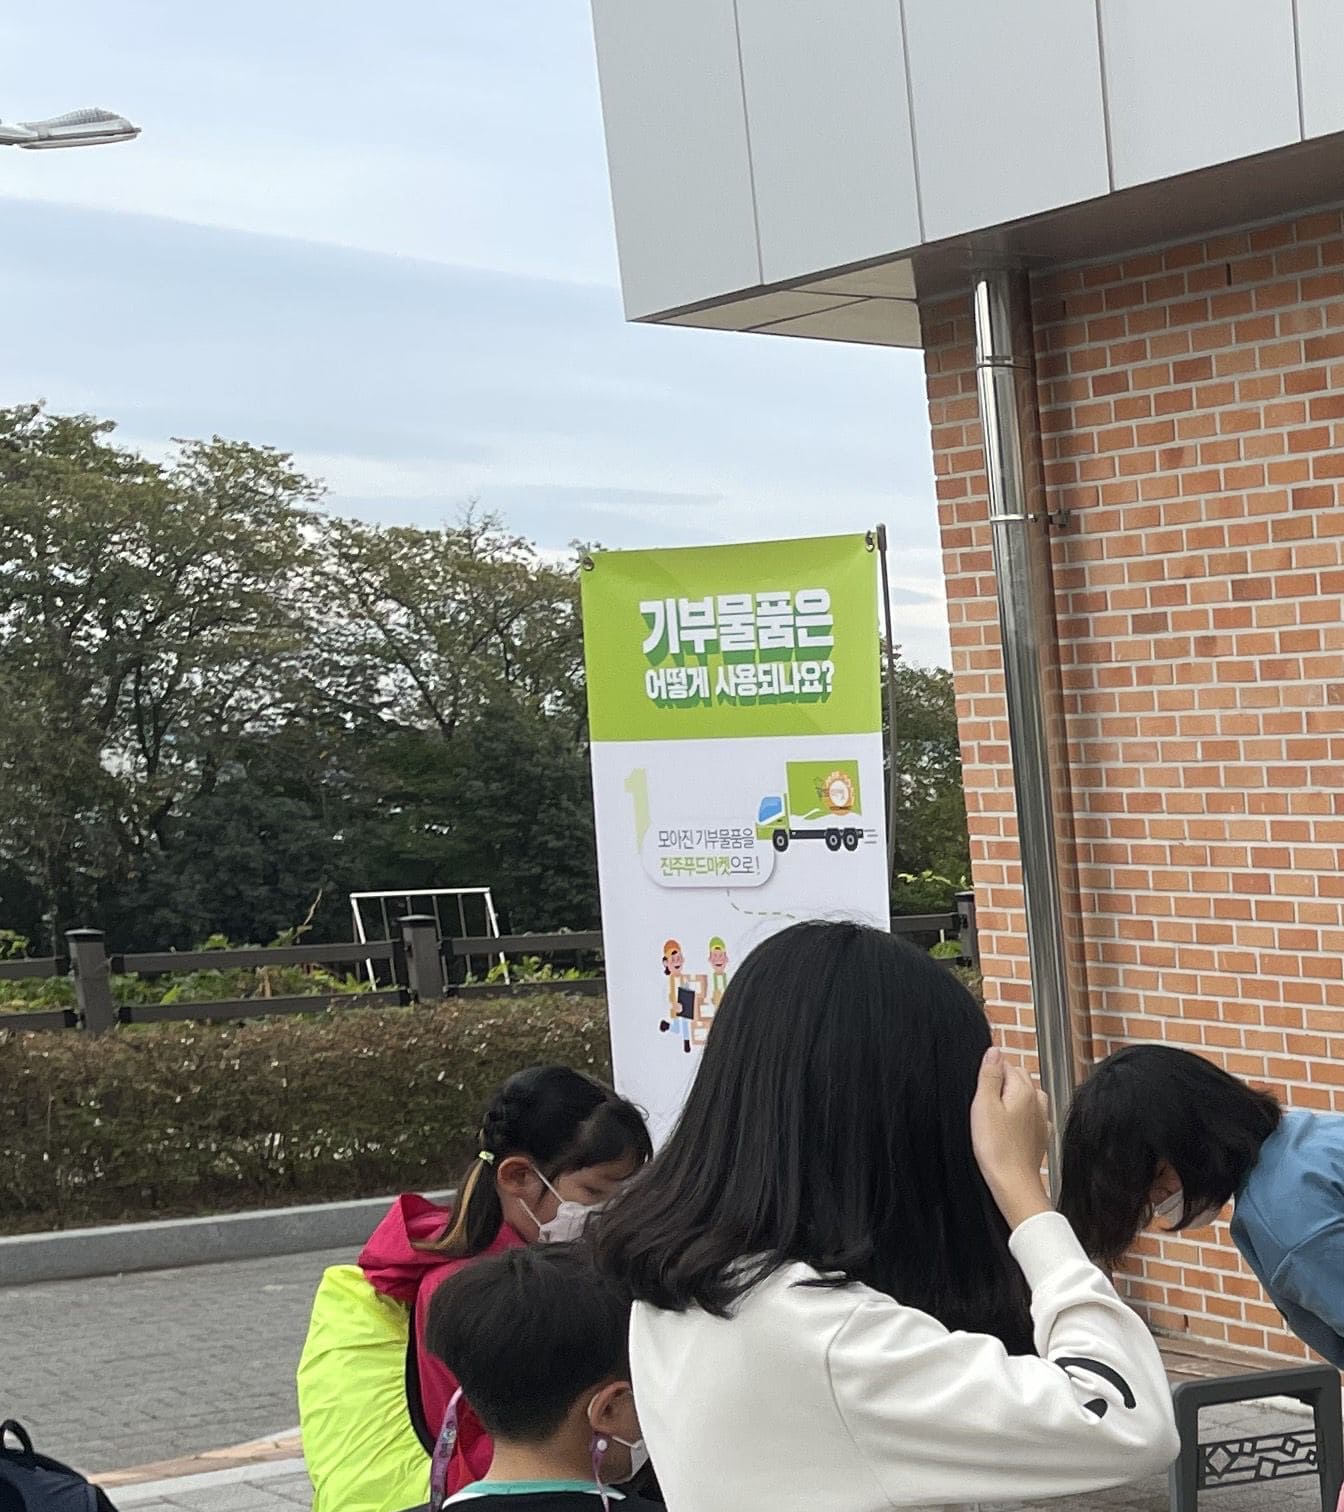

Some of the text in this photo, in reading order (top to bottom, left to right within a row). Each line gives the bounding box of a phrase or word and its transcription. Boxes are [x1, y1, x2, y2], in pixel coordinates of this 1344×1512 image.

[640, 588, 834, 656] 기부물품은
[645, 661, 834, 701] 어떻게 사용되나요?
[658, 828, 754, 849] 모아진 기부물품을
[660, 856, 760, 876] 진주푸드마켓으로!
